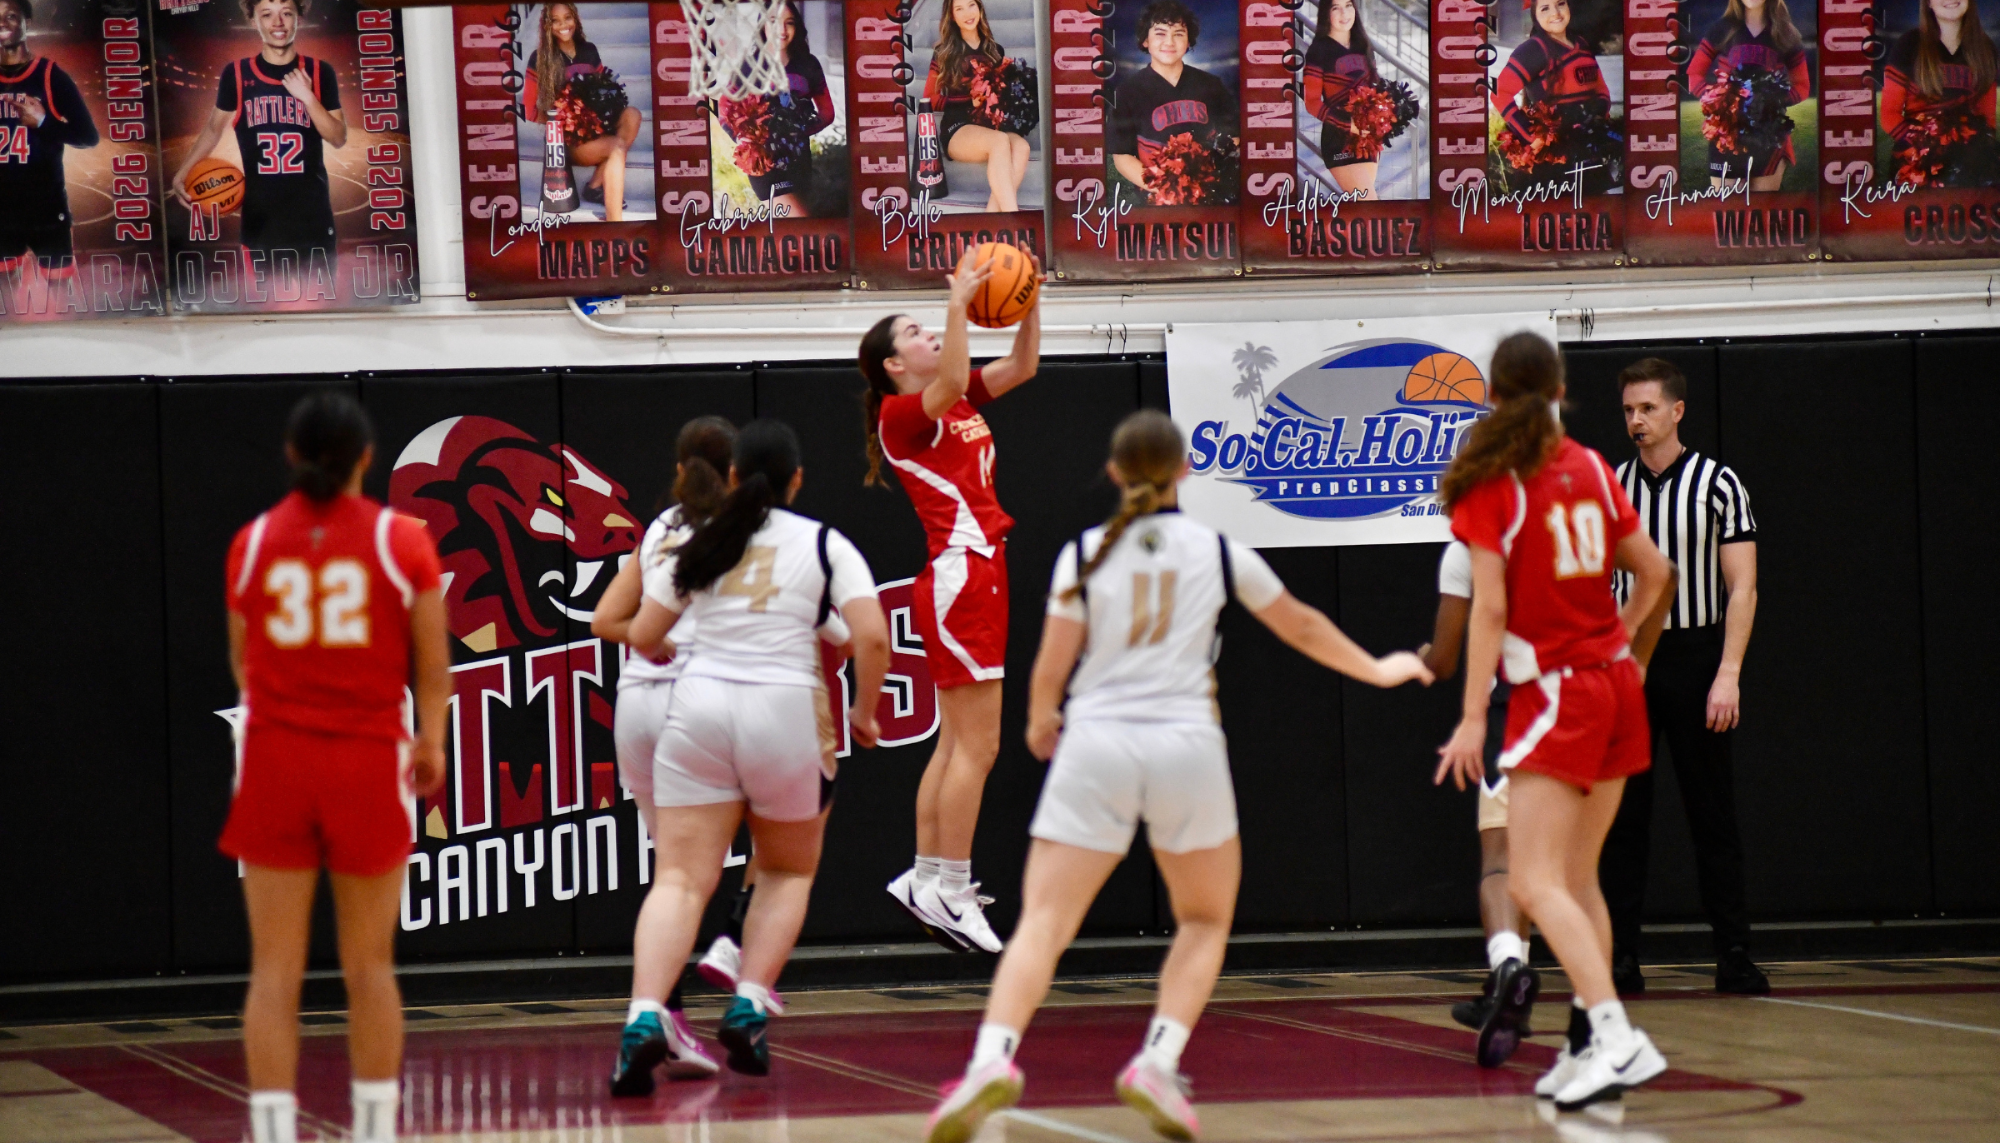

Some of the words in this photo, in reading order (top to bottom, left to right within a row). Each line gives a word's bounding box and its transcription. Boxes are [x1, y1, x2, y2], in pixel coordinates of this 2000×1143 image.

[103, 17, 147, 142] SENIOR
[356, 8, 399, 132] SENIOR
[1474, 0, 1499, 96] 202
[1665, 0, 1693, 95] 202
[461, 23, 519, 219] SENIOR
[656, 19, 713, 214] SENIOR
[855, 16, 909, 211] SENIOR
[1053, 9, 1104, 202] SENIOR
[1151, 99, 1209, 132] CHHS
[1245, 2, 1295, 197] SENIOR
[1438, 0, 1487, 192] SENIOR
[1628, 0, 1678, 190] SENIOR
[193, 174, 236, 196] Wilson
[257, 132, 305, 175] 32
[366, 142, 406, 231] 2026
[112, 153, 152, 242] 2026
[189, 202, 221, 241] AJ
[679, 184, 792, 253] Gabriela
[874, 189, 942, 252] Belle
[1072, 181, 1132, 249] Kyle
[1263, 178, 1368, 234] Addison
[1452, 162, 1603, 234] Monserratt
[1645, 155, 1754, 226] Annabel
[1840, 164, 1917, 225] Keira
[490, 200, 572, 257] London
[537, 236, 651, 281] MAPPS
[685, 233, 842, 277] CAMACHO
[1115, 221, 1237, 263] MATSUI
[1286, 216, 1422, 259] BASQUEZ
[1521, 211, 1614, 252] LOERA
[1712, 207, 1810, 249] WAND
[0, 252, 165, 316] WARA
[176, 247, 336, 304] OJEDA
[352, 243, 418, 299] JR
[1278, 474, 1438, 496] PrepClassi
[1400, 503, 1426, 518] San
[1545, 500, 1607, 581] 10
[263, 558, 373, 650] 32
[715, 546, 781, 614] 4
[1126, 568, 1179, 648] 11
[400, 814, 619, 932] CANYON
